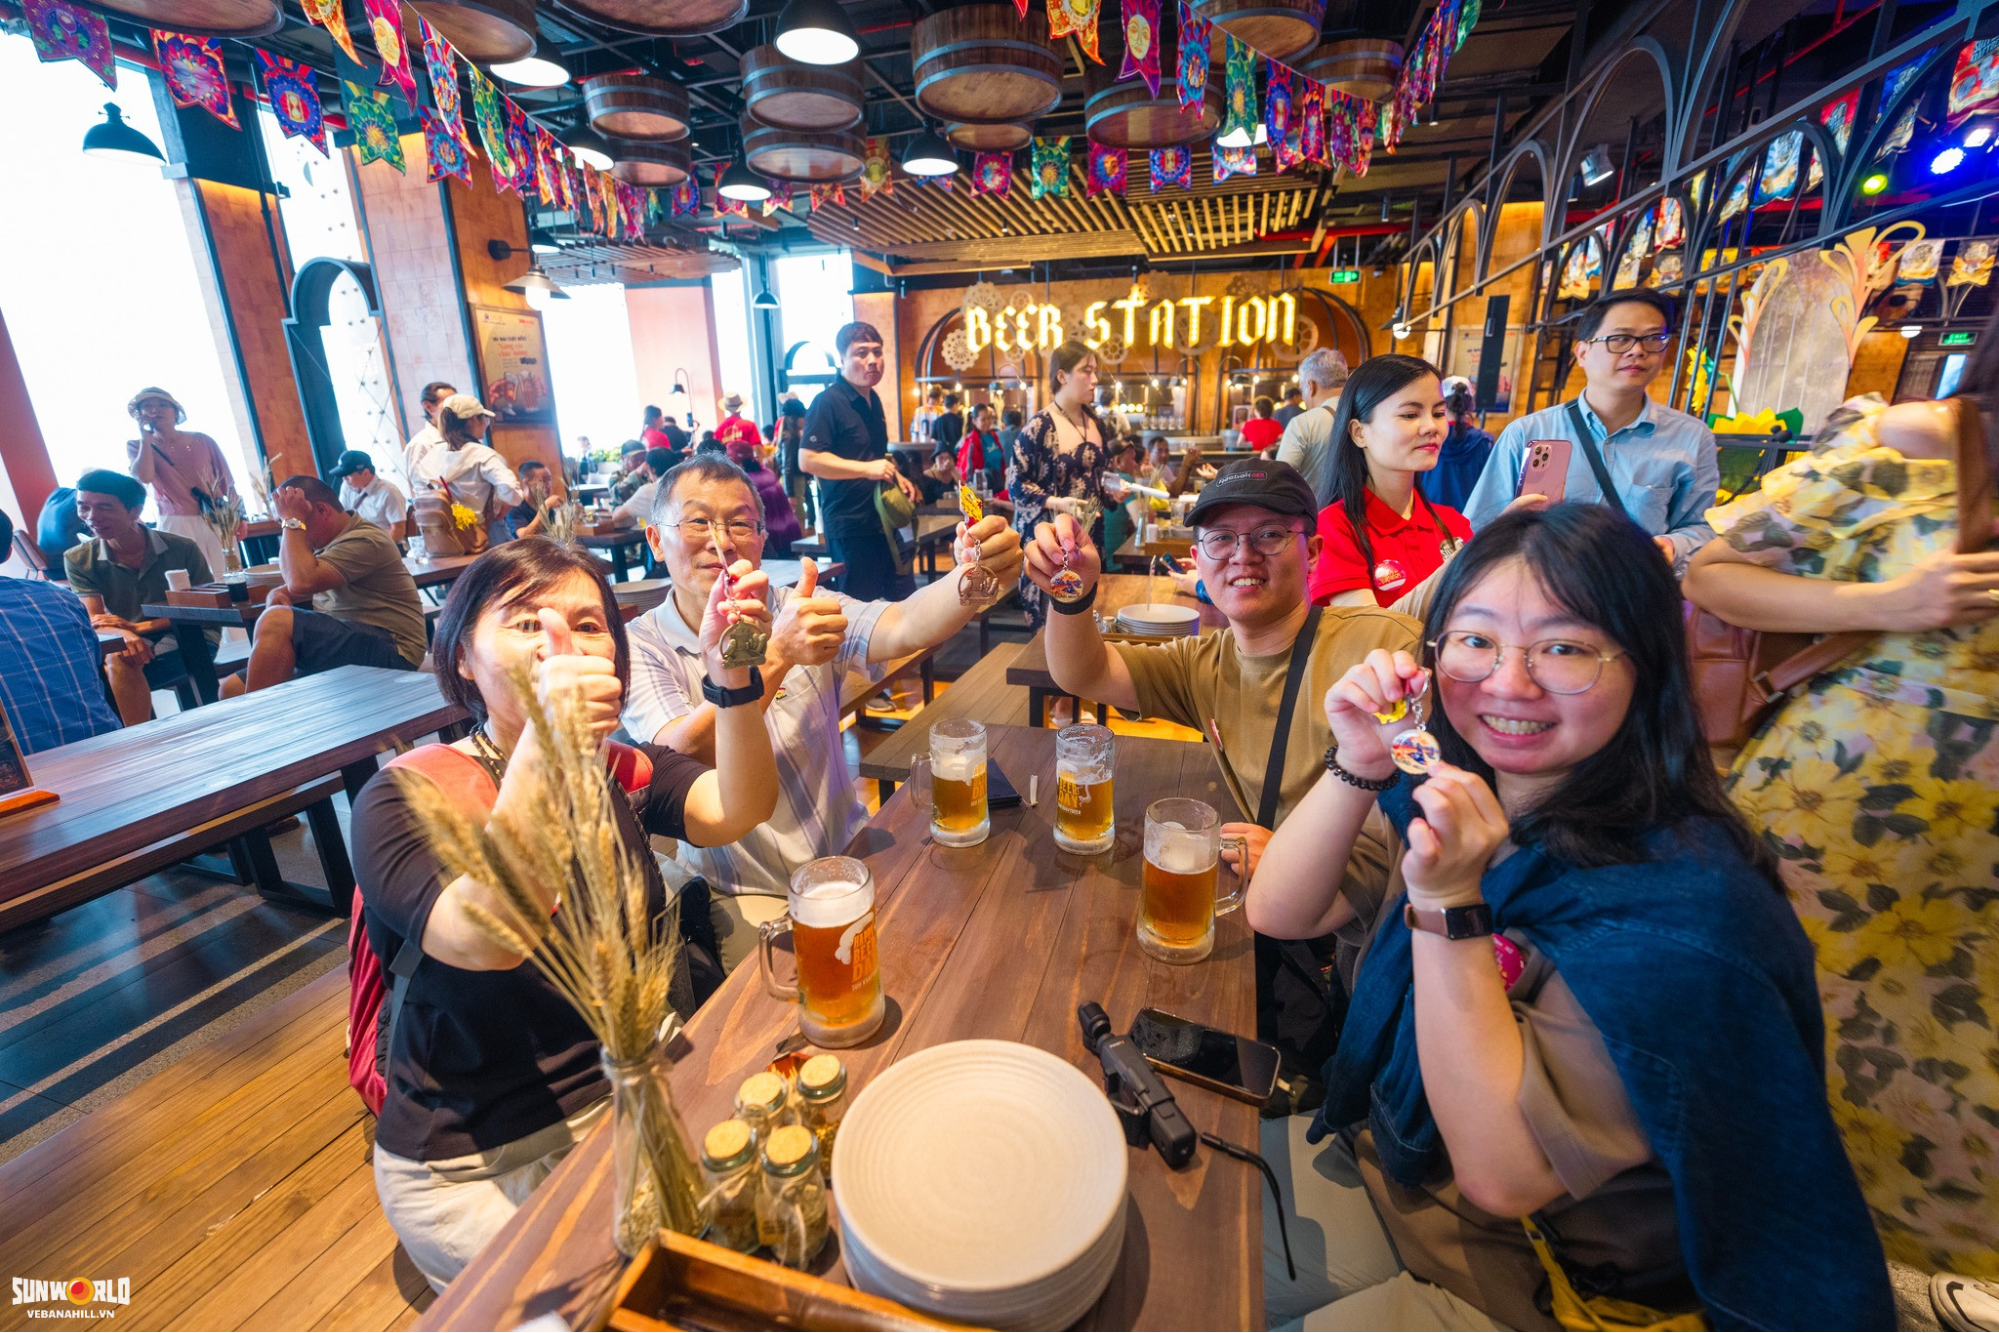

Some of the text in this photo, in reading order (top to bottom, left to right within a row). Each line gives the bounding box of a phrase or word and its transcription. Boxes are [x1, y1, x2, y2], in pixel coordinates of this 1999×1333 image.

[965, 286, 1297, 353] BEER STATION
[1218, 472, 1251, 484] Reebok
